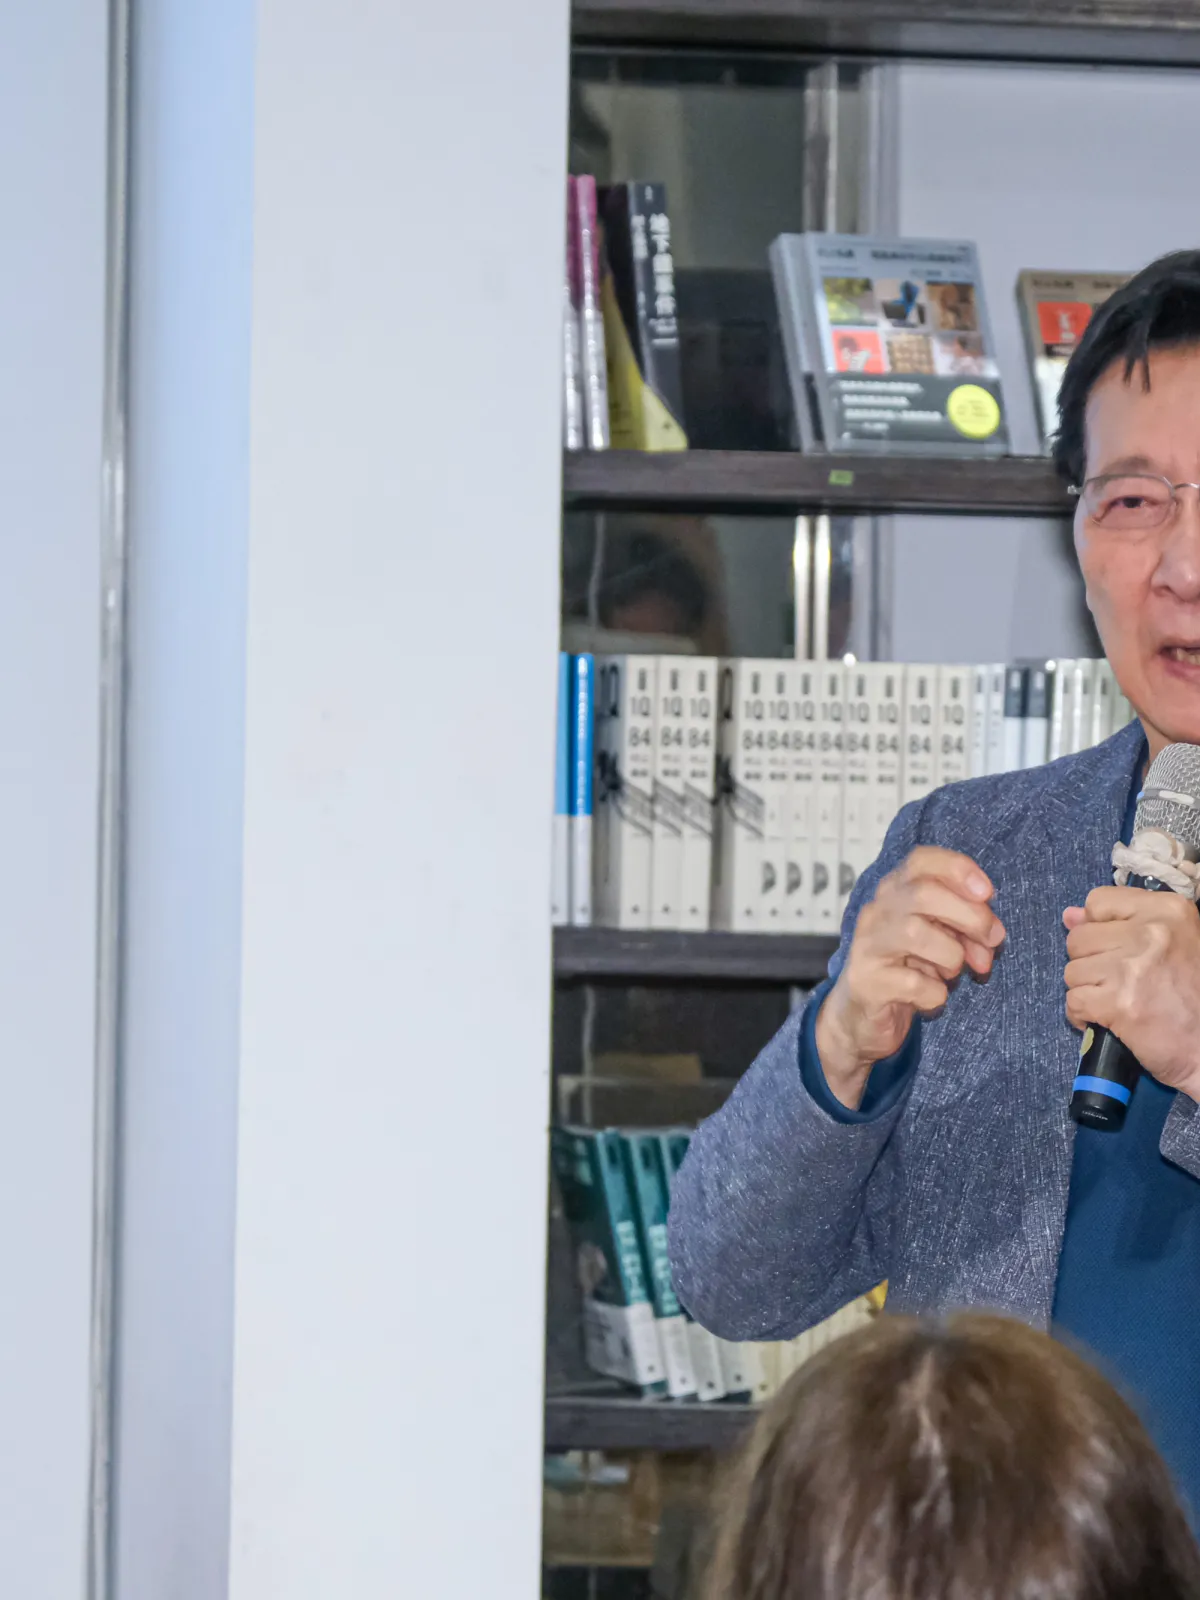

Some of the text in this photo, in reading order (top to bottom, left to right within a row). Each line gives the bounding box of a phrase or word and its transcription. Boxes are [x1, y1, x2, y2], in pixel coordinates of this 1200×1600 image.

[629, 727, 650, 748] 84
[661, 727, 683, 748] 84
[688, 727, 710, 749] 84
[743, 729, 763, 750] 84
[767, 729, 789, 750] 84
[792, 729, 814, 750] 84
[819, 730, 842, 751] 84
[847, 731, 870, 752] 84
[876, 732, 898, 753] 84
[909, 733, 931, 753] 84
[941, 733, 964, 754] 84
